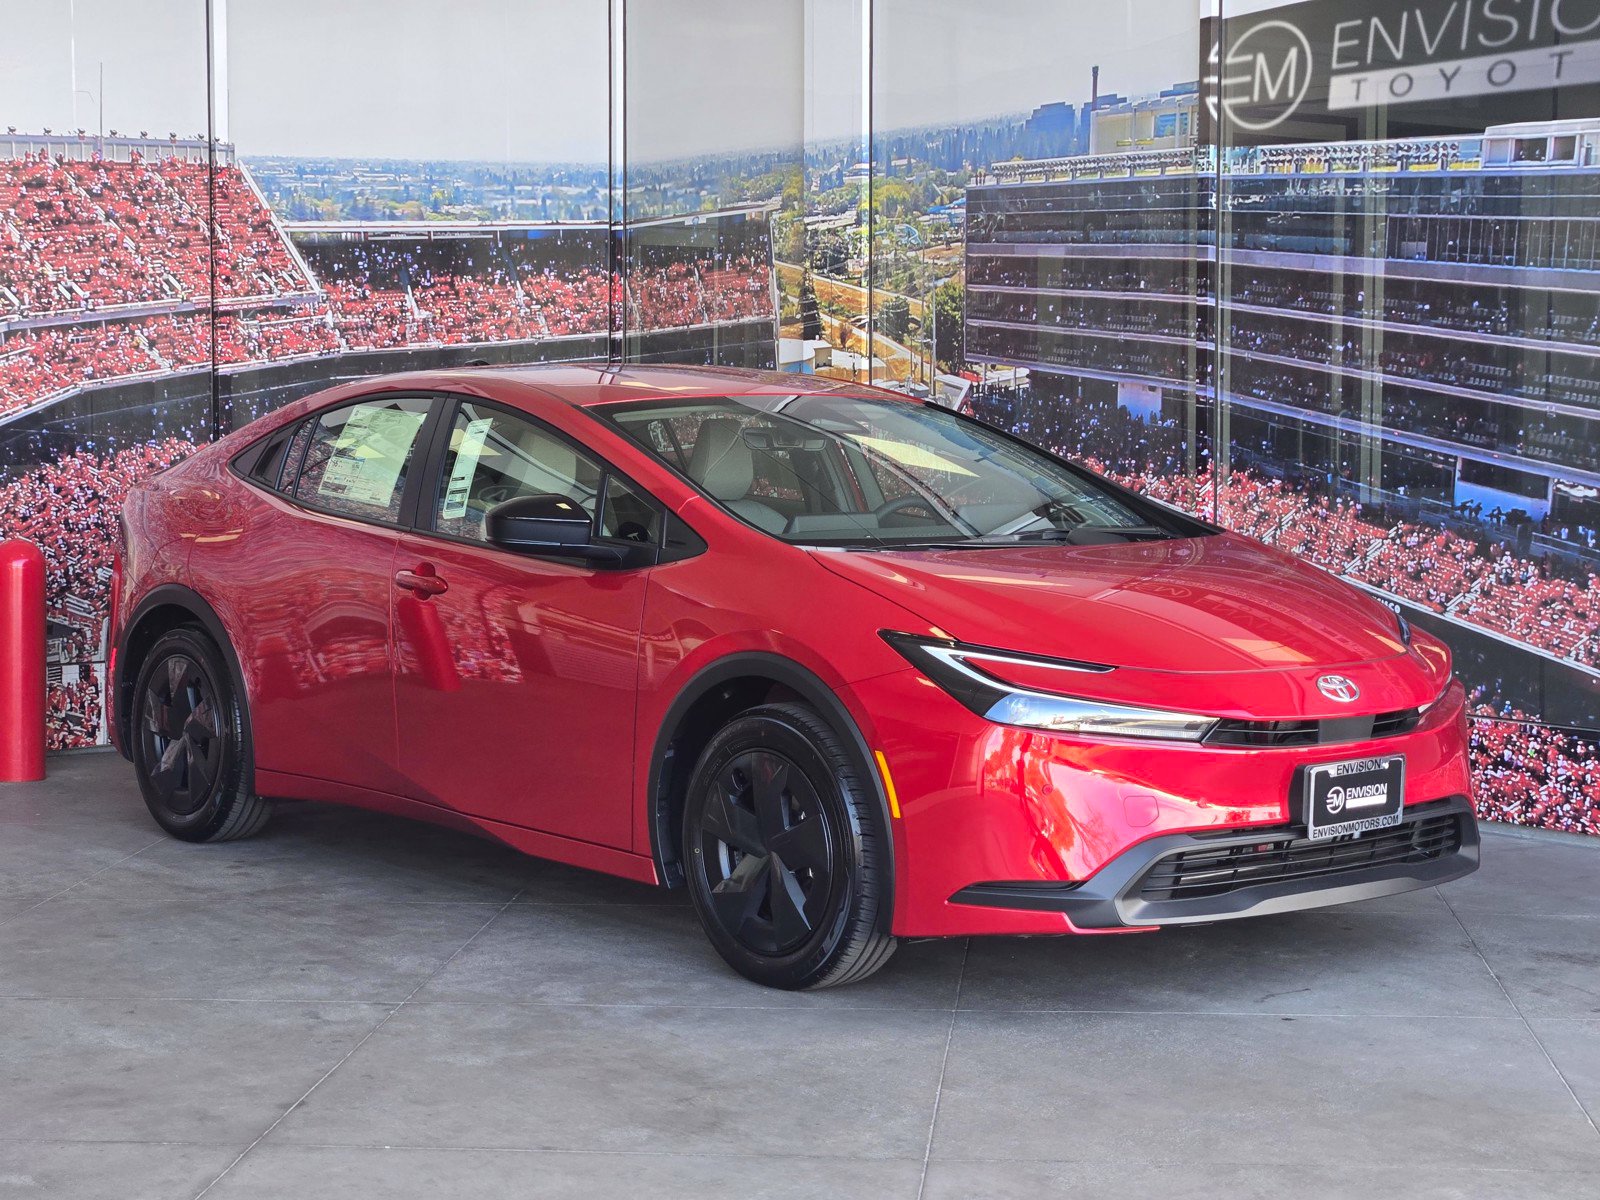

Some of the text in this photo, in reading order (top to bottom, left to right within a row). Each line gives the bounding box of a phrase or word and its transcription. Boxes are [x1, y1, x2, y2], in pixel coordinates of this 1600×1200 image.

[1352, 51, 1573, 101] TOYOT
[1337, 759, 1381, 775] ENVISION
[1347, 783, 1388, 800] ENVISION
[1314, 815, 1398, 838] ENVISIONMOTORS.COM
